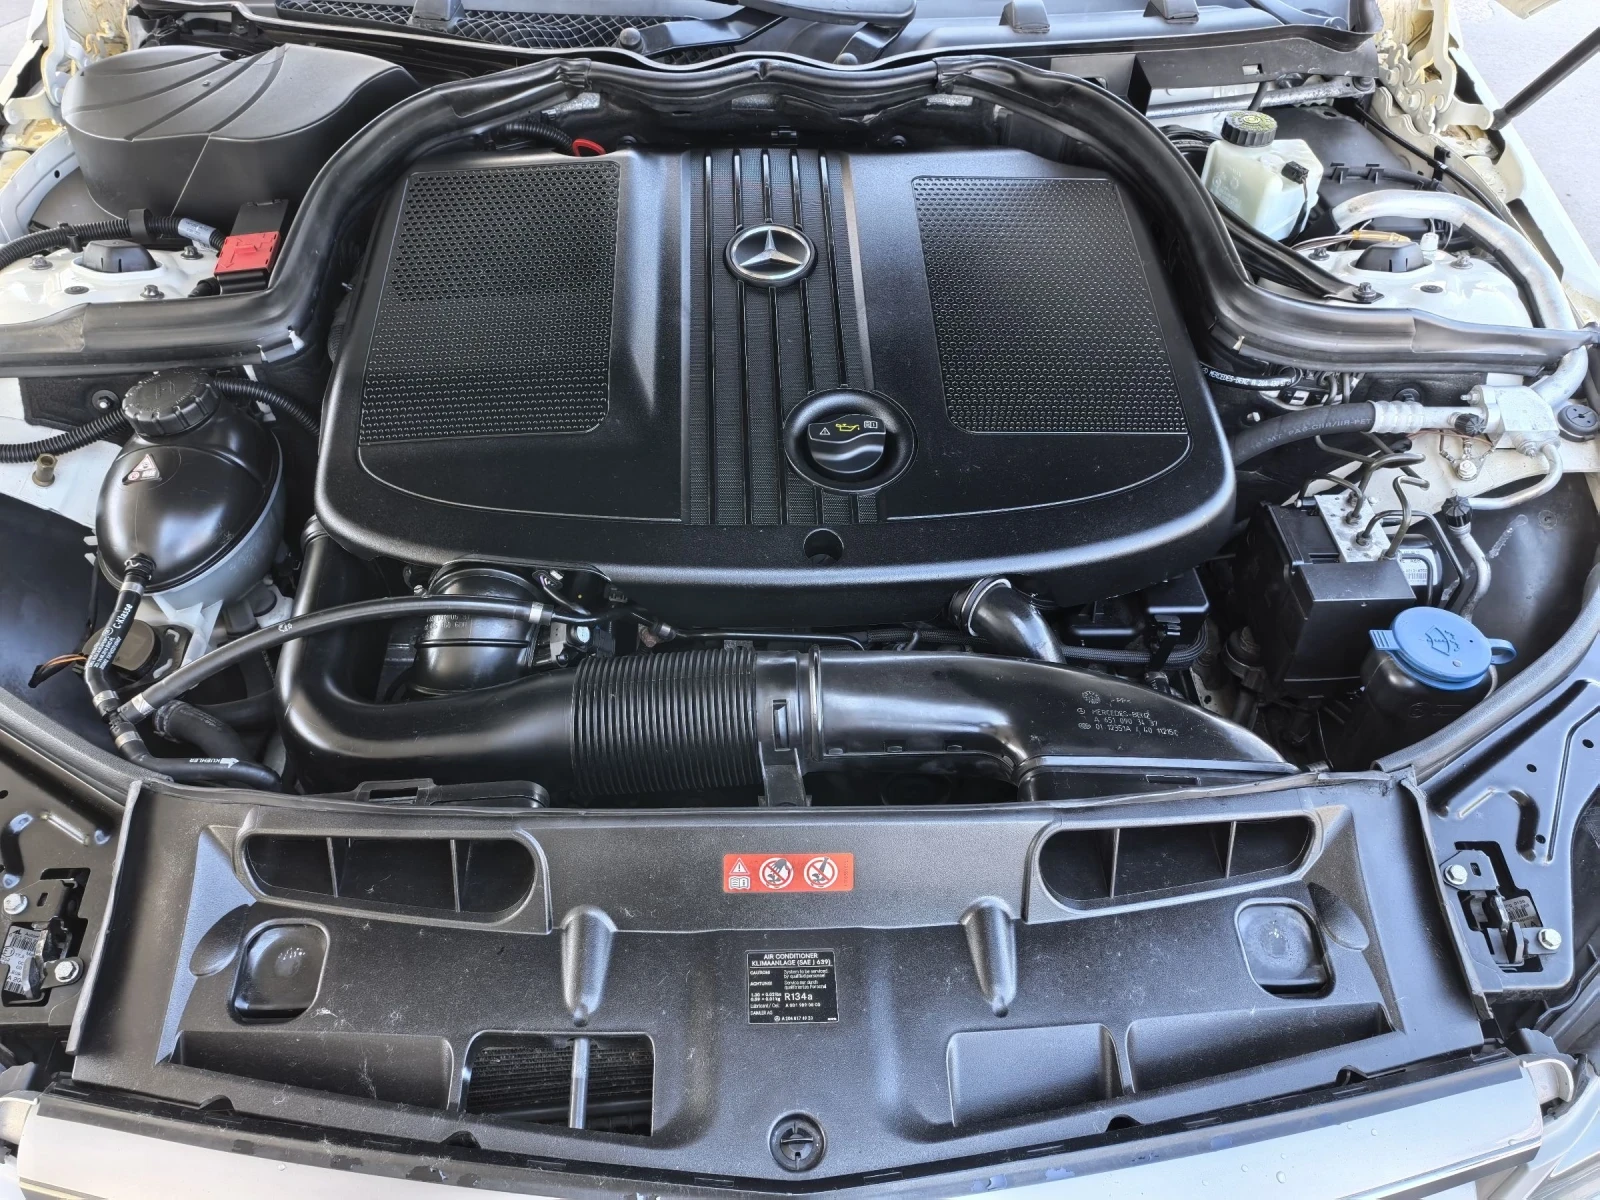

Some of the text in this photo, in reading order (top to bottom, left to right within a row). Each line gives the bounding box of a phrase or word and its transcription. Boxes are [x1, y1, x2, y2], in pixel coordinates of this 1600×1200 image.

[1209, 370, 1250, 385] MERCEDES-BENZ
[1092, 708, 1151, 719] MERCEDES-BENZ
[784, 992, 813, 1001] R134a
